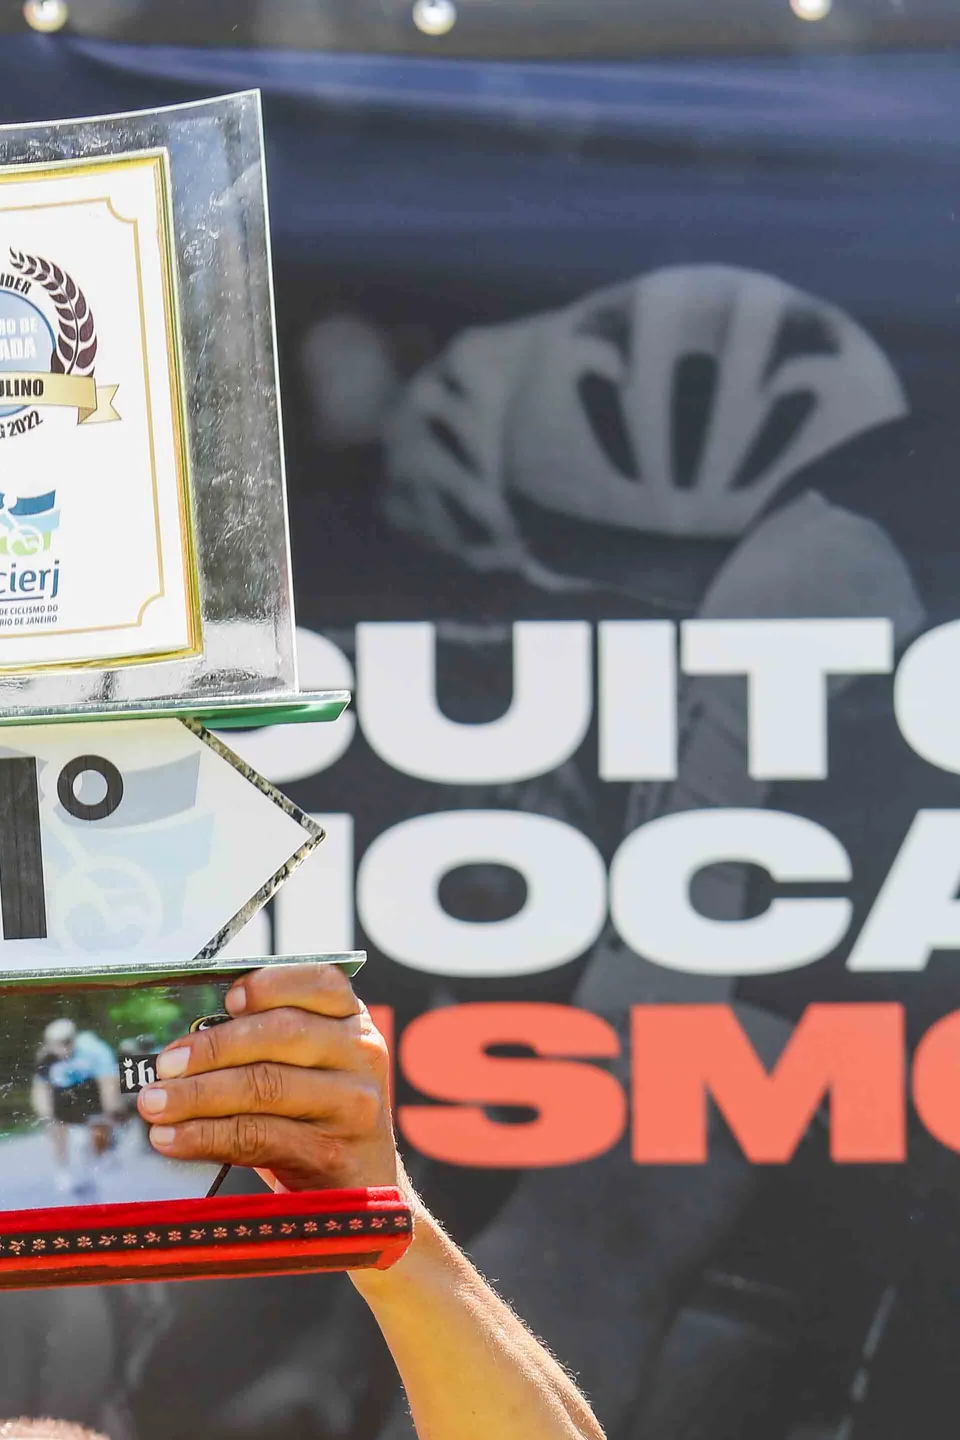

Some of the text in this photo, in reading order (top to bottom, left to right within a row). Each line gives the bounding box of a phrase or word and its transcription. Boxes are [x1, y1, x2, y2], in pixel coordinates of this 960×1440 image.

[20, 316, 38, 333] DE
[6, 410, 44, 437] 2022
[0, 607, 8, 616] DE
[10, 605, 46, 615] CICLISMO
[48, 604, 59, 613] DO
[0, 618, 13, 627] RIO
[14, 616, 24, 625] DE
[26, 615, 58, 625] JANEIRO
